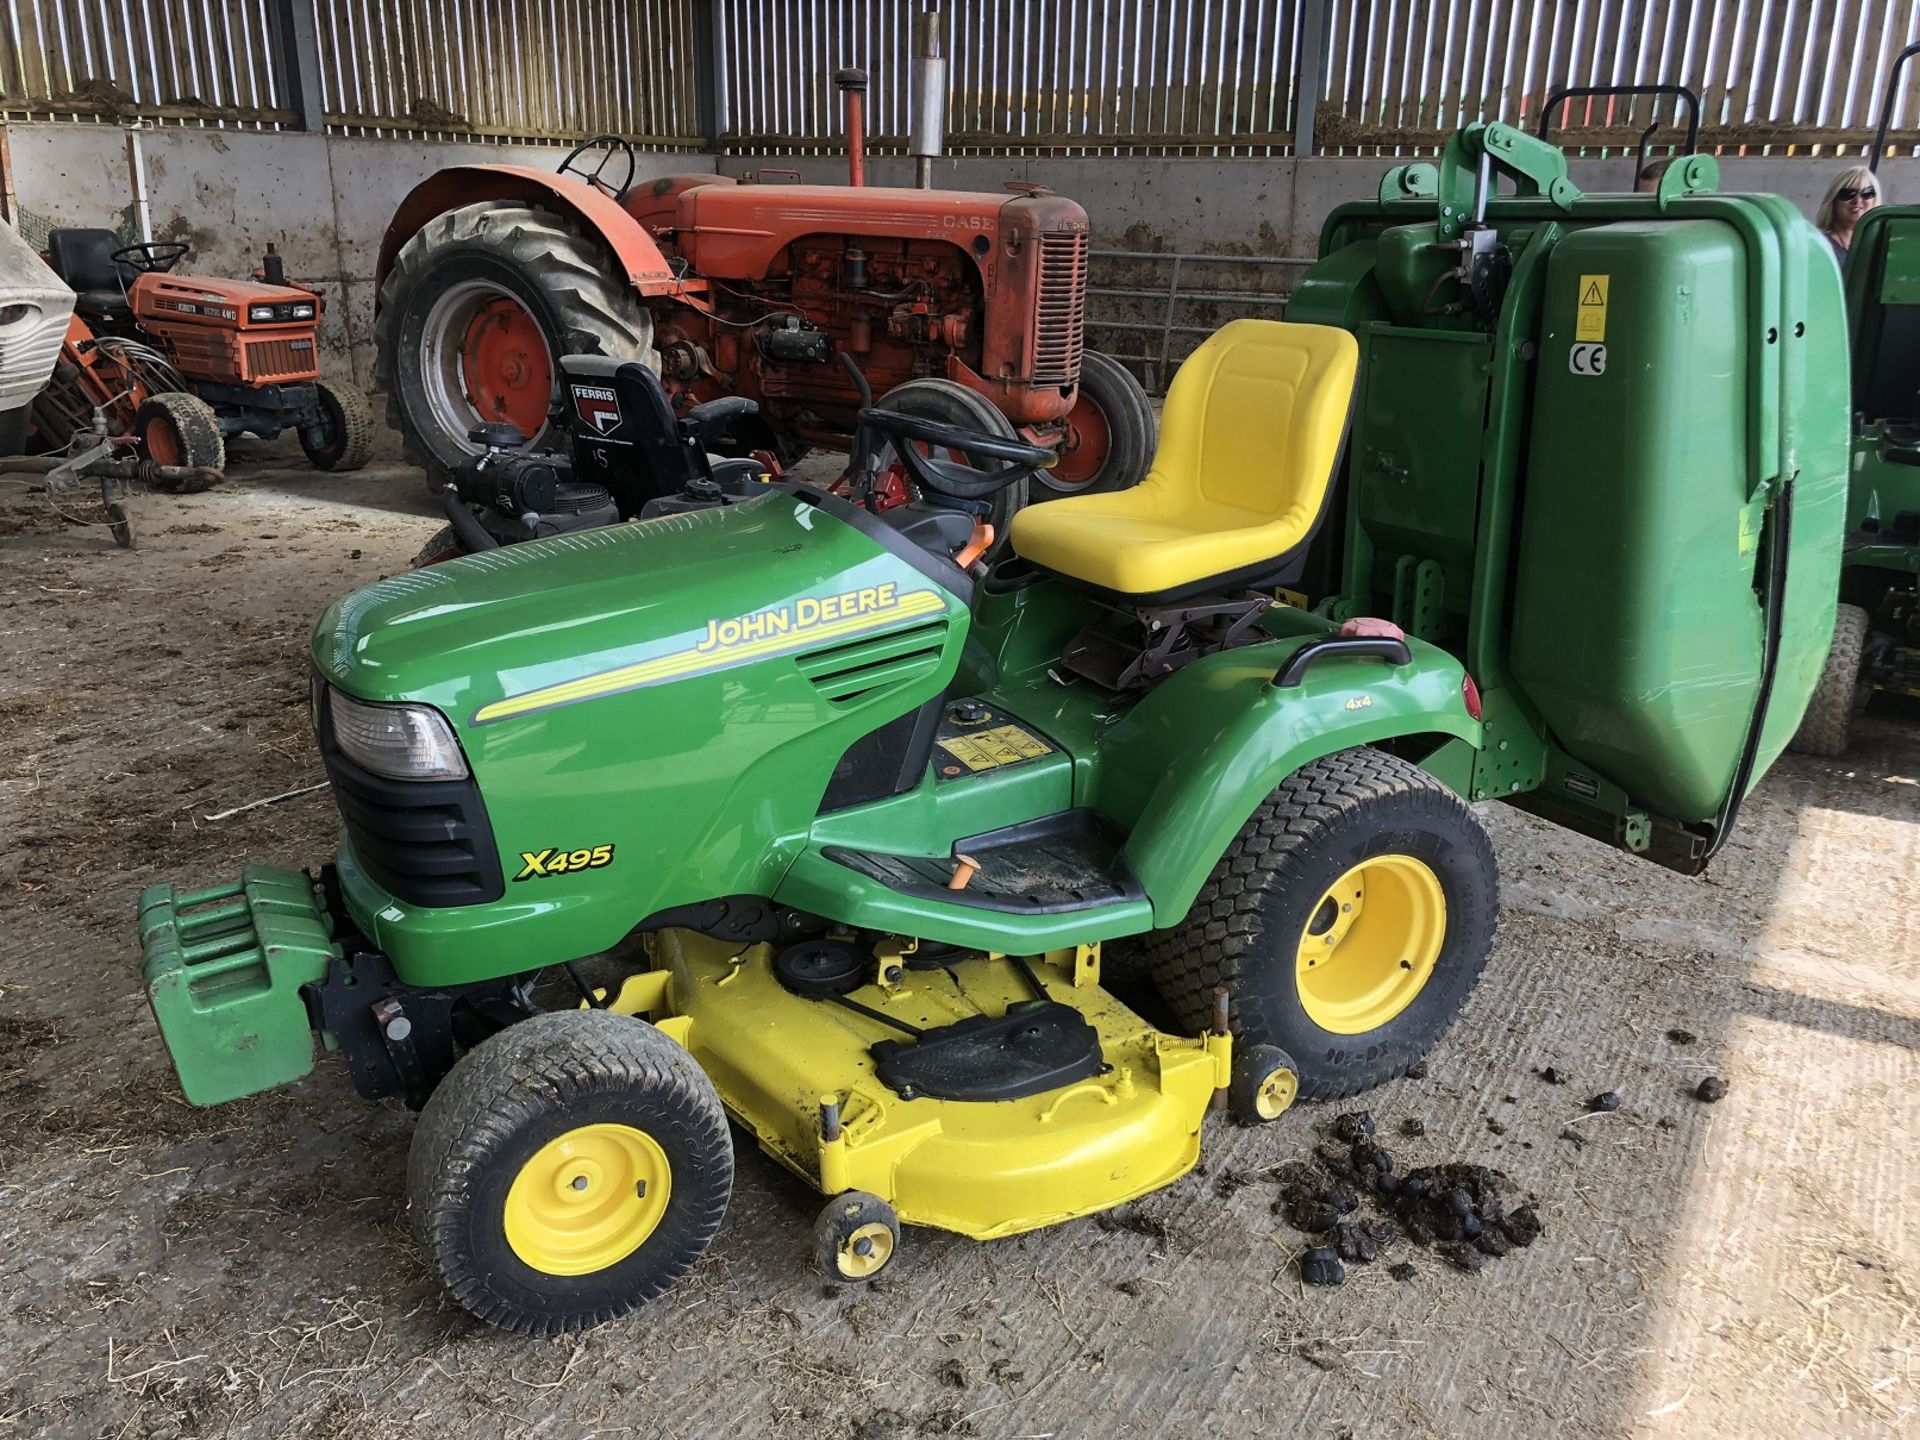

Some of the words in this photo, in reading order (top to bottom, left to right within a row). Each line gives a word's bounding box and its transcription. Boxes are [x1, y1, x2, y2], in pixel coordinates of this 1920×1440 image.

[943, 215, 995, 231] CASE
[222, 307, 237, 321] 4WD
[1573, 346, 1603, 373] CE
[575, 388, 614, 401] FERRIS
[696, 608, 790, 651] JOHN
[796, 582, 896, 627] DEERE
[1345, 695, 1374, 711] 4x4
[513, 844, 615, 882] X495
